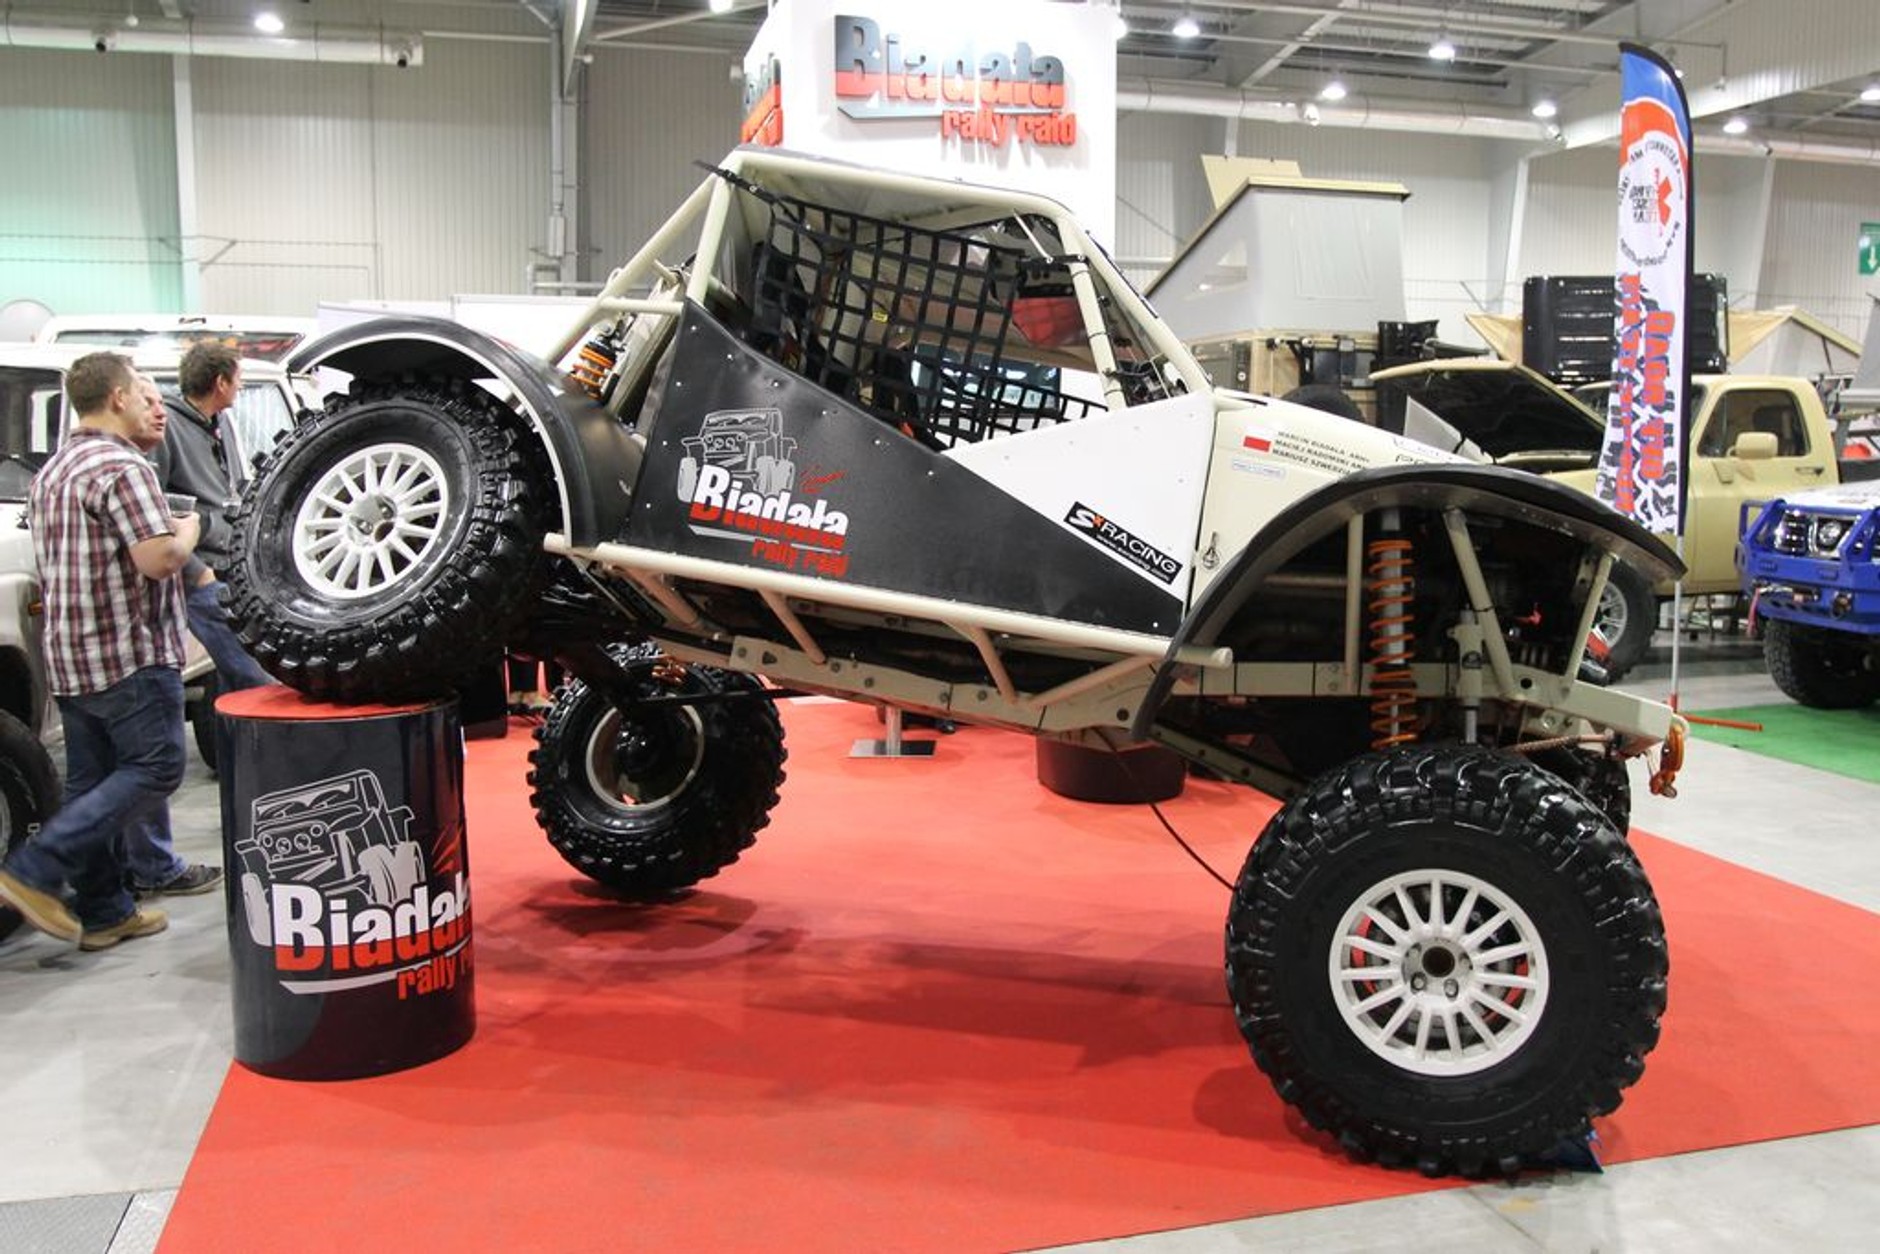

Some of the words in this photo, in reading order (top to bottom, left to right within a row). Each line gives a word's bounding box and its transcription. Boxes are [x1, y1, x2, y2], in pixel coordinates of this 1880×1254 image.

[942, 109, 1010, 146] rally
[1018, 113, 1077, 146] raid
[752, 539, 799, 569] rally
[803, 551, 850, 577] raid
[396, 954, 458, 1001] rally
